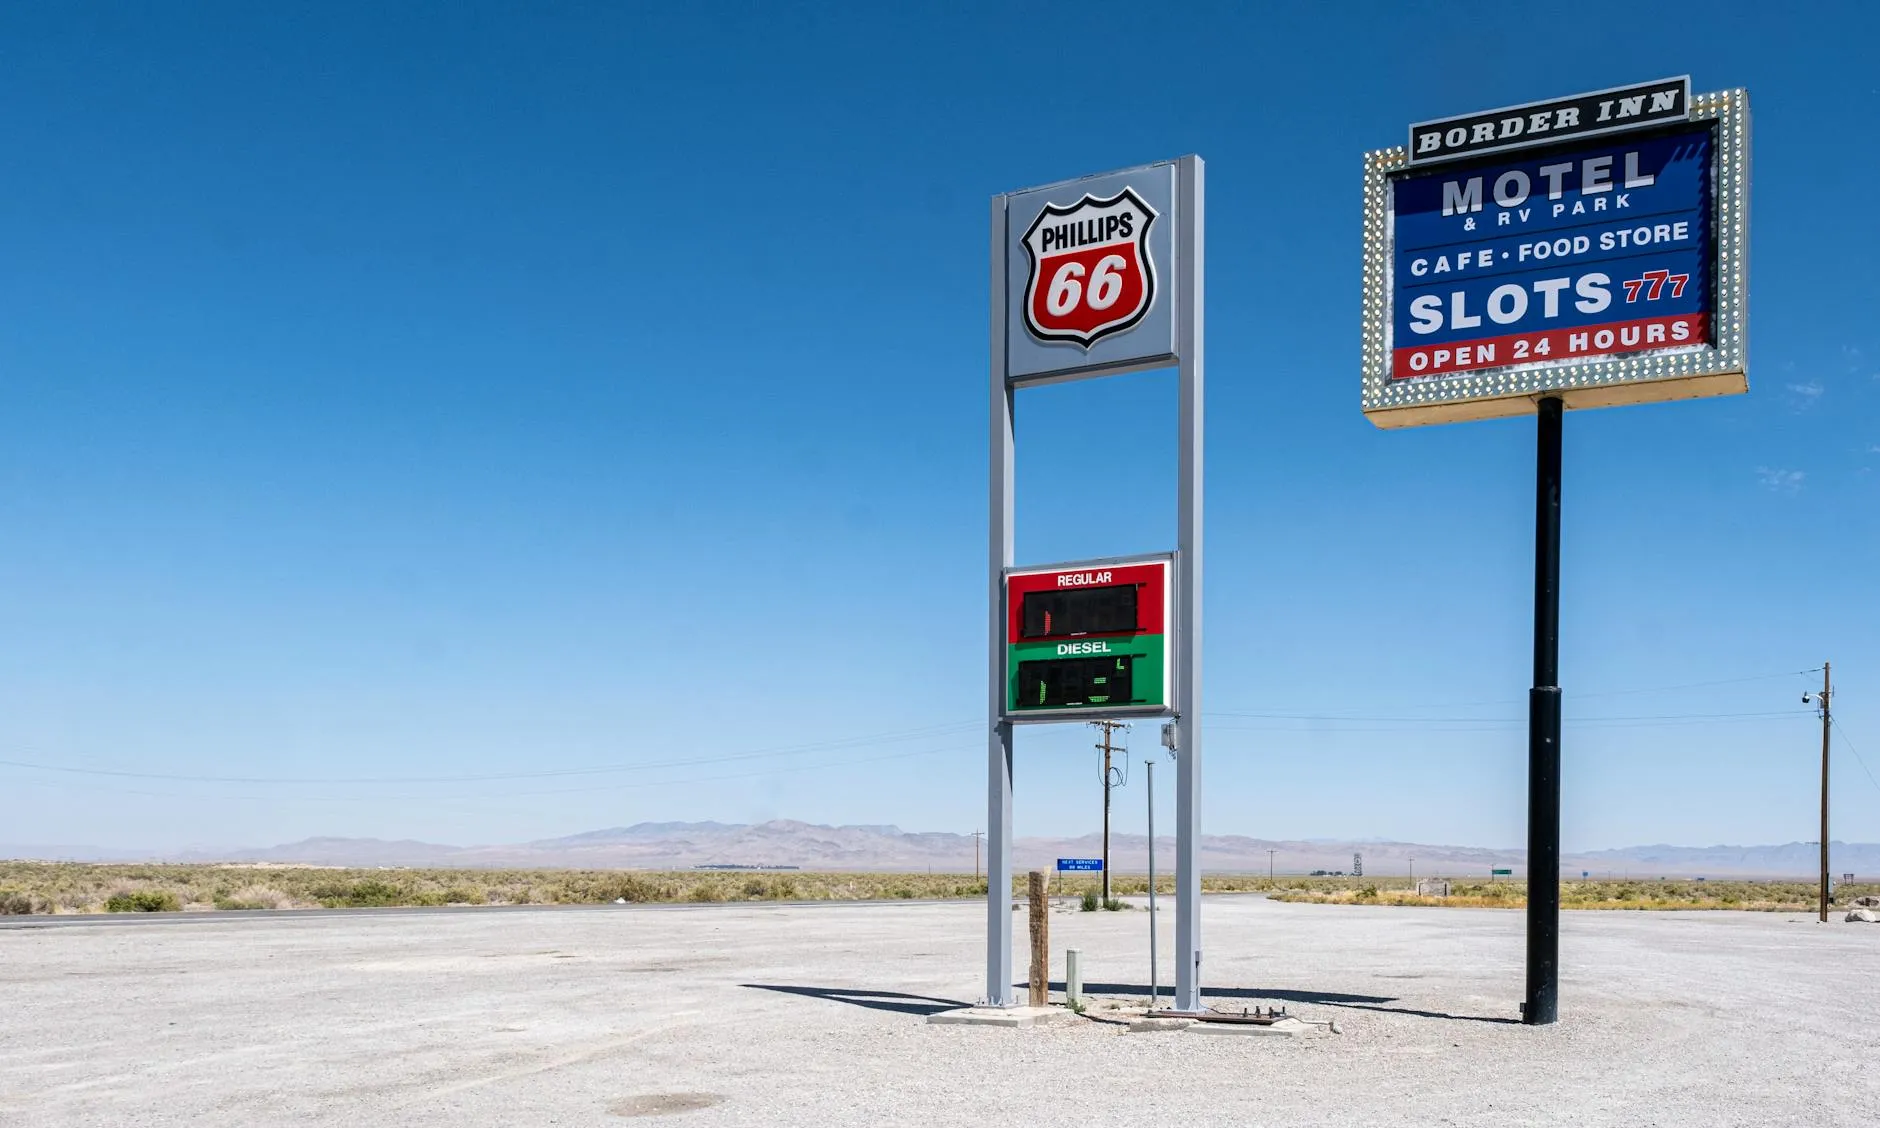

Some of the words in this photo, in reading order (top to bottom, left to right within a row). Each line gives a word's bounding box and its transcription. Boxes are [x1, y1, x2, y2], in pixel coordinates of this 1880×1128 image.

[1416, 106, 1580, 154] BORDER
[1596, 89, 1680, 123] INN
[1442, 151, 1655, 217] MOTEL
[1042, 212, 1133, 252] PHILLIPS
[1464, 217, 1476, 231] &
[1498, 209, 1531, 226] RV
[1553, 193, 1630, 218] PARK
[1411, 249, 1493, 276] CAFE
[1519, 235, 1589, 262] FOOD
[1600, 222, 1689, 250] STORE
[1046, 254, 1127, 316] 66
[1409, 273, 1612, 334] SLOTS
[1623, 269, 1690, 304] 777
[1409, 343, 1495, 371] OPEN
[1513, 336, 1550, 358] 24
[1570, 320, 1690, 352] HOURS
[1057, 572, 1112, 586] REGULAR
[1057, 642, 1111, 655] DIESEL
